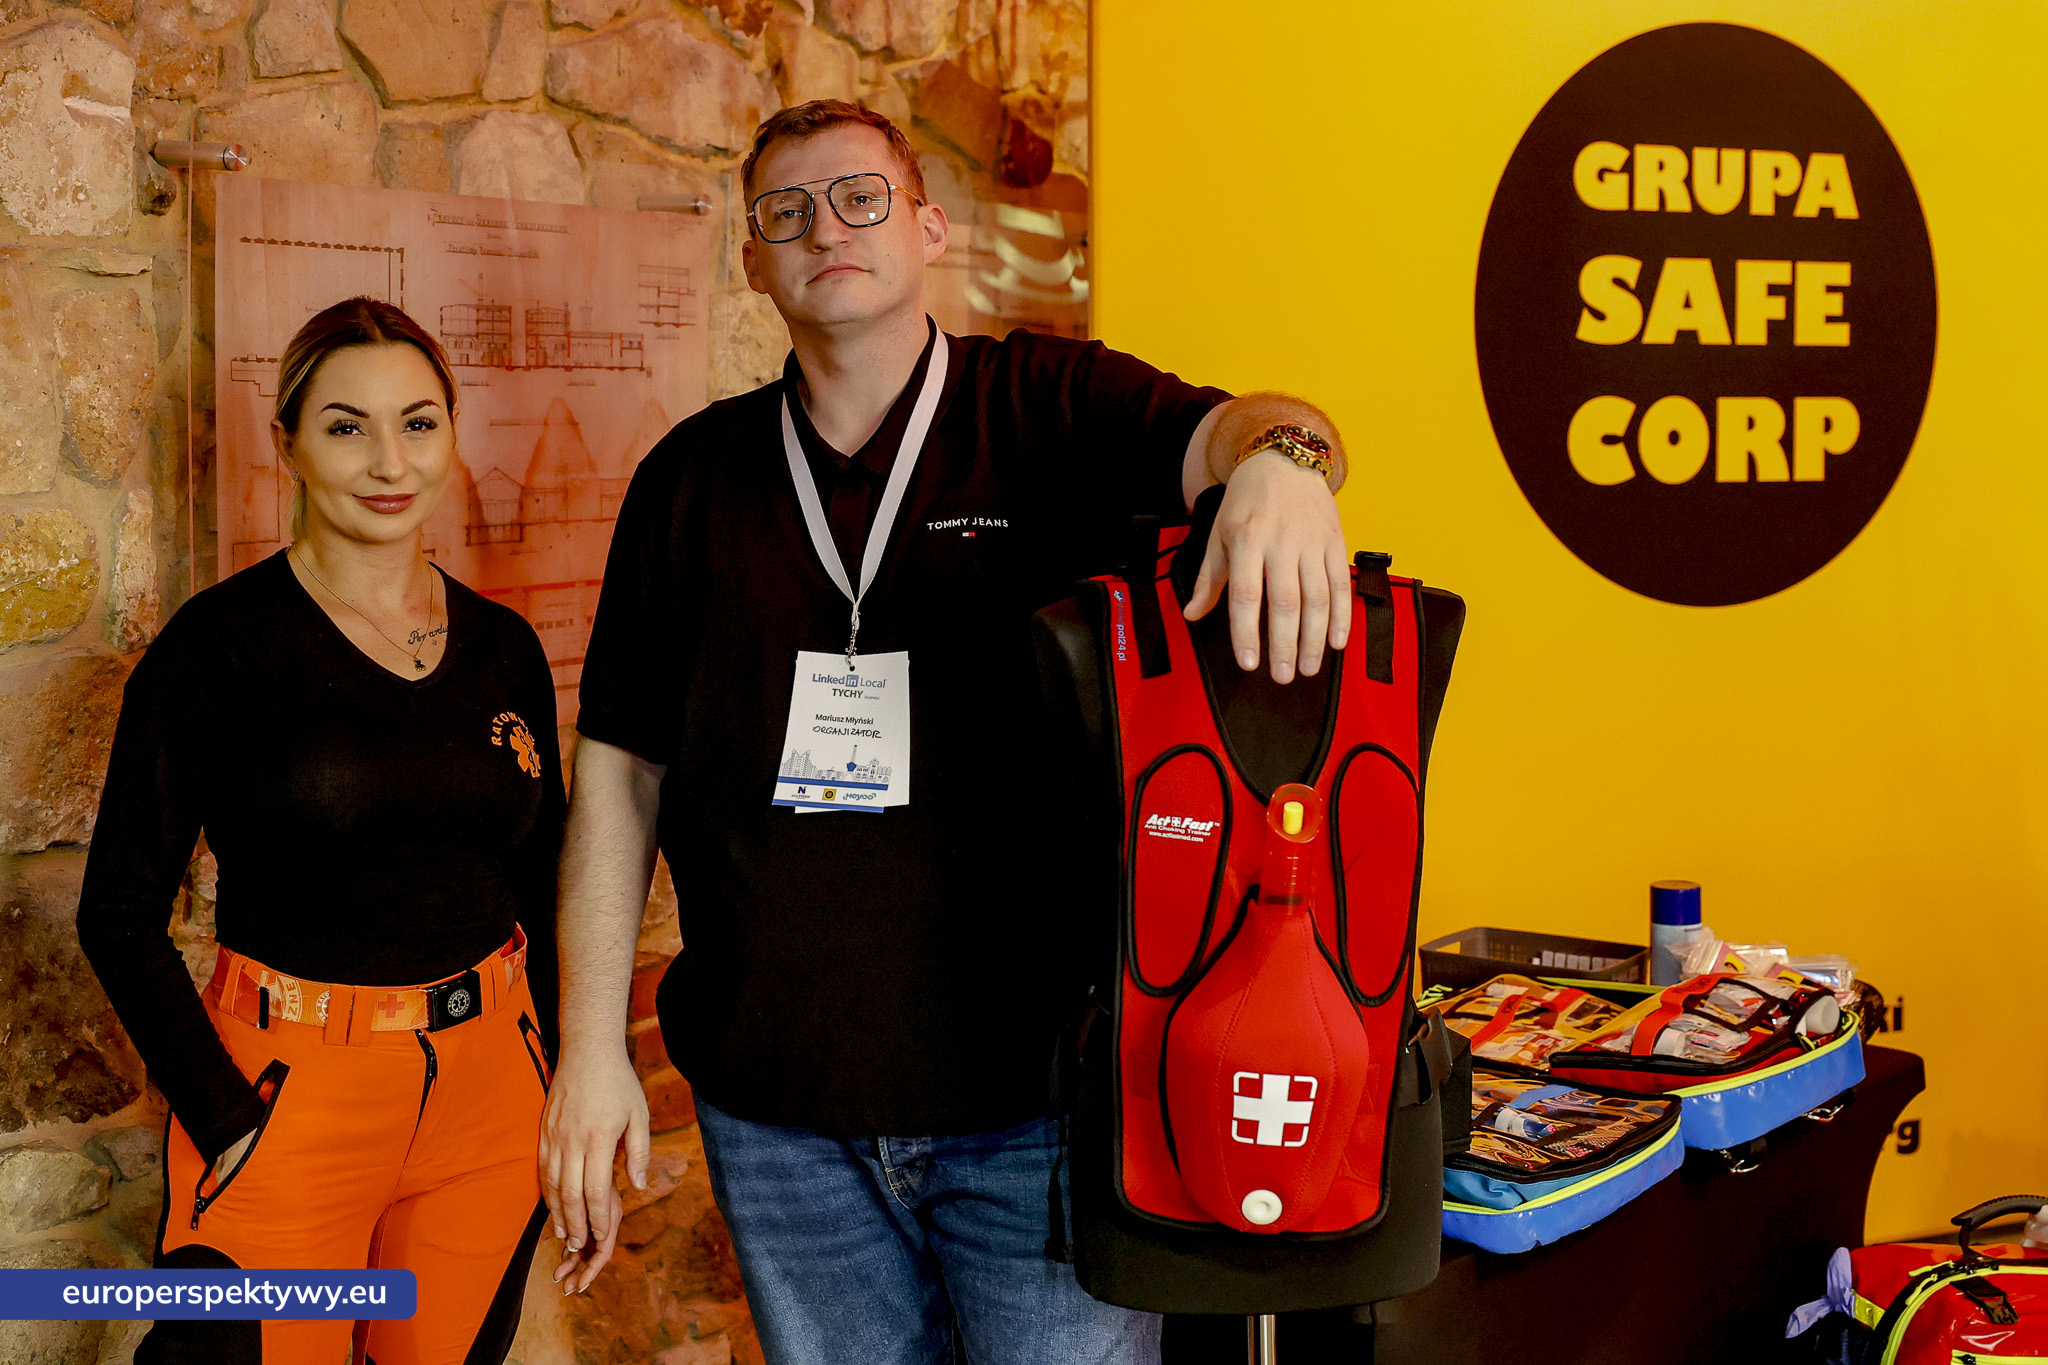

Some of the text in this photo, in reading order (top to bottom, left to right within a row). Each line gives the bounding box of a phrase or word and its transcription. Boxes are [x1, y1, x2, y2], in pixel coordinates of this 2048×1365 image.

[1572, 140, 1860, 219] GRUPA
[1575, 253, 1852, 347] SAFE
[1566, 394, 1861, 486] CORP
[927, 517, 1009, 531] TOMMY JEANS
[860, 678, 887, 689] Local
[832, 688, 863, 699] TYCHY
[815, 713, 874, 726] Mariusz Młyński
[812, 725, 882, 739] ORGANIZATOR
[1146, 813, 1171, 827] Act
[1158, 825, 1186, 834] Choking
[1187, 828, 1212, 837] Trainer
